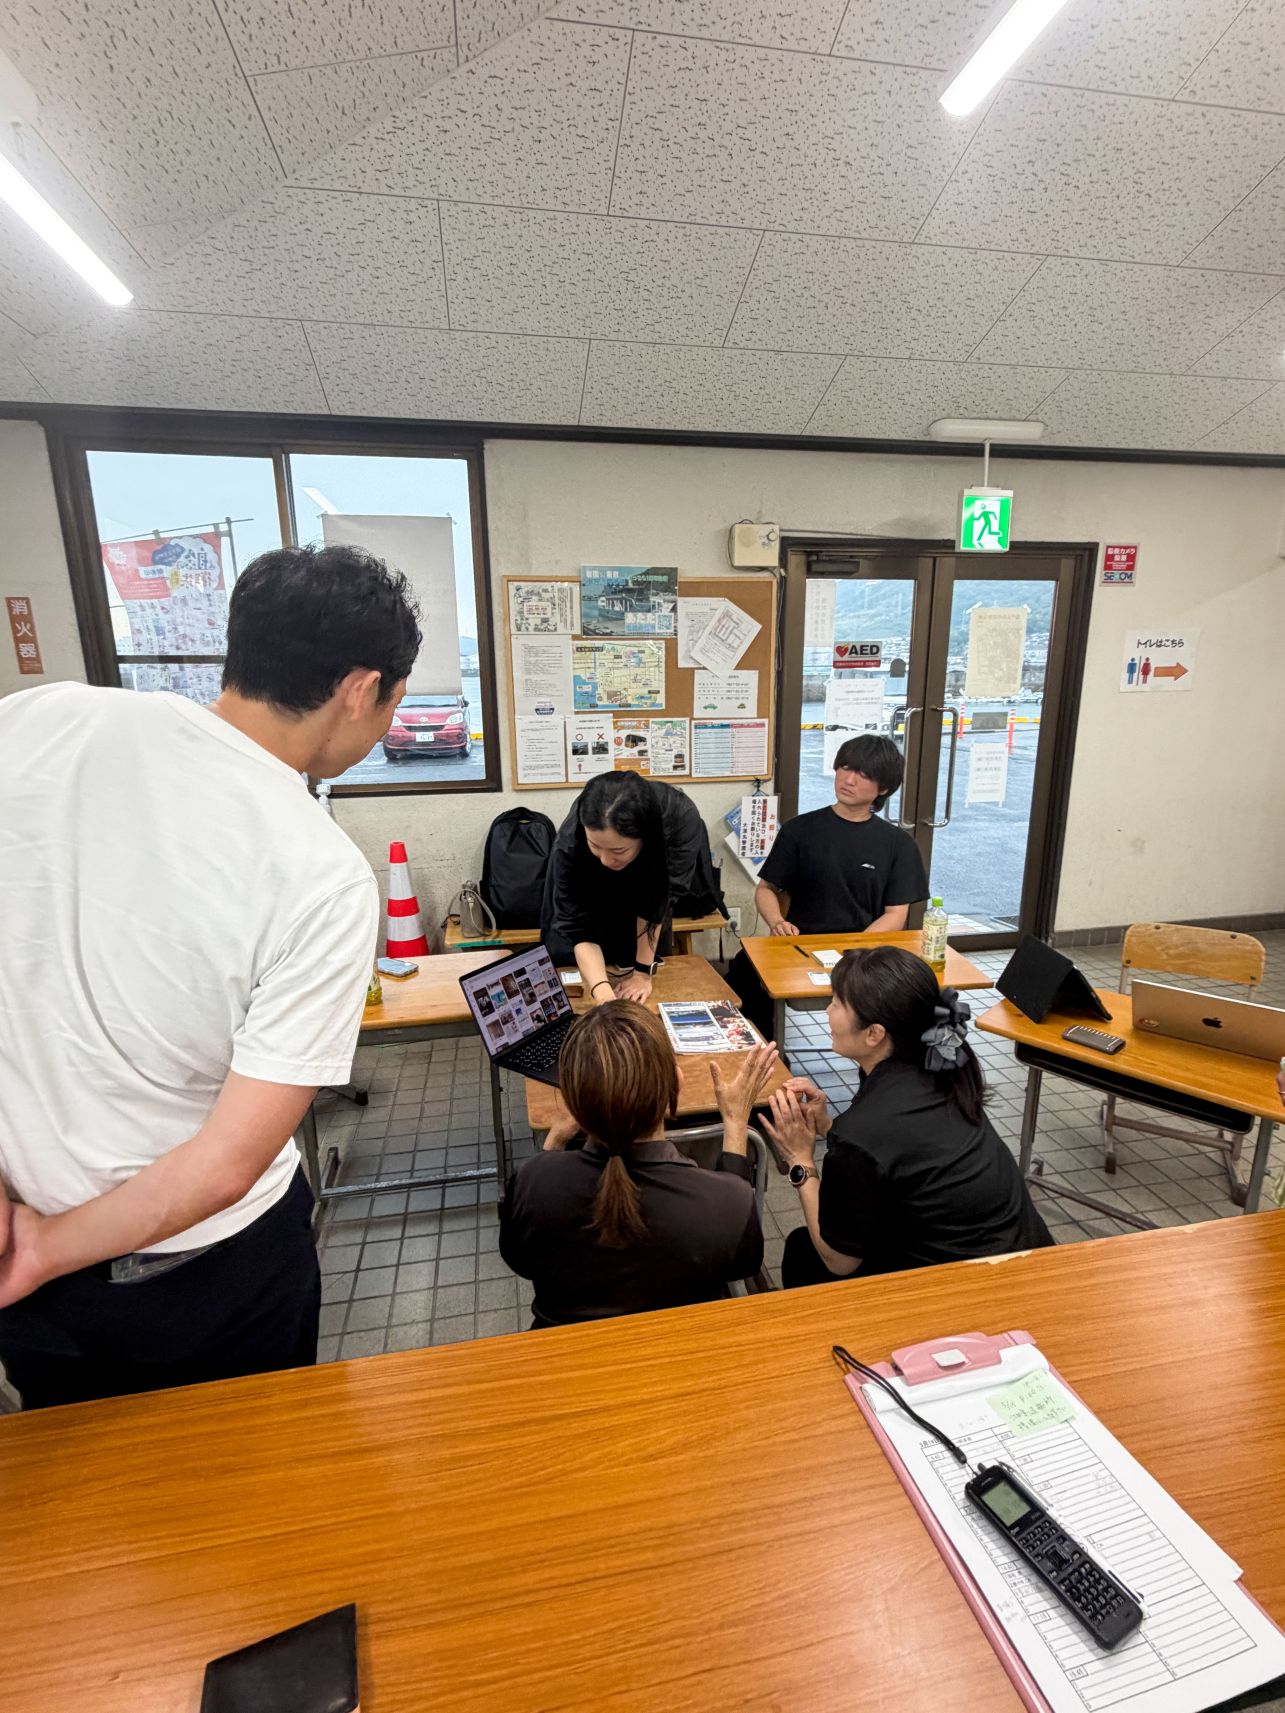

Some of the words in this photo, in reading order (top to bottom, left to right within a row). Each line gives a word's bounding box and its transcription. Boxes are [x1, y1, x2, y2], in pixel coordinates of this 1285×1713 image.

[1104, 572, 1133, 580] SECOM
[10, 599, 37, 657] 消火器
[1136, 638, 1185, 649] トイレはこちら
[848, 644, 880, 656] AED
